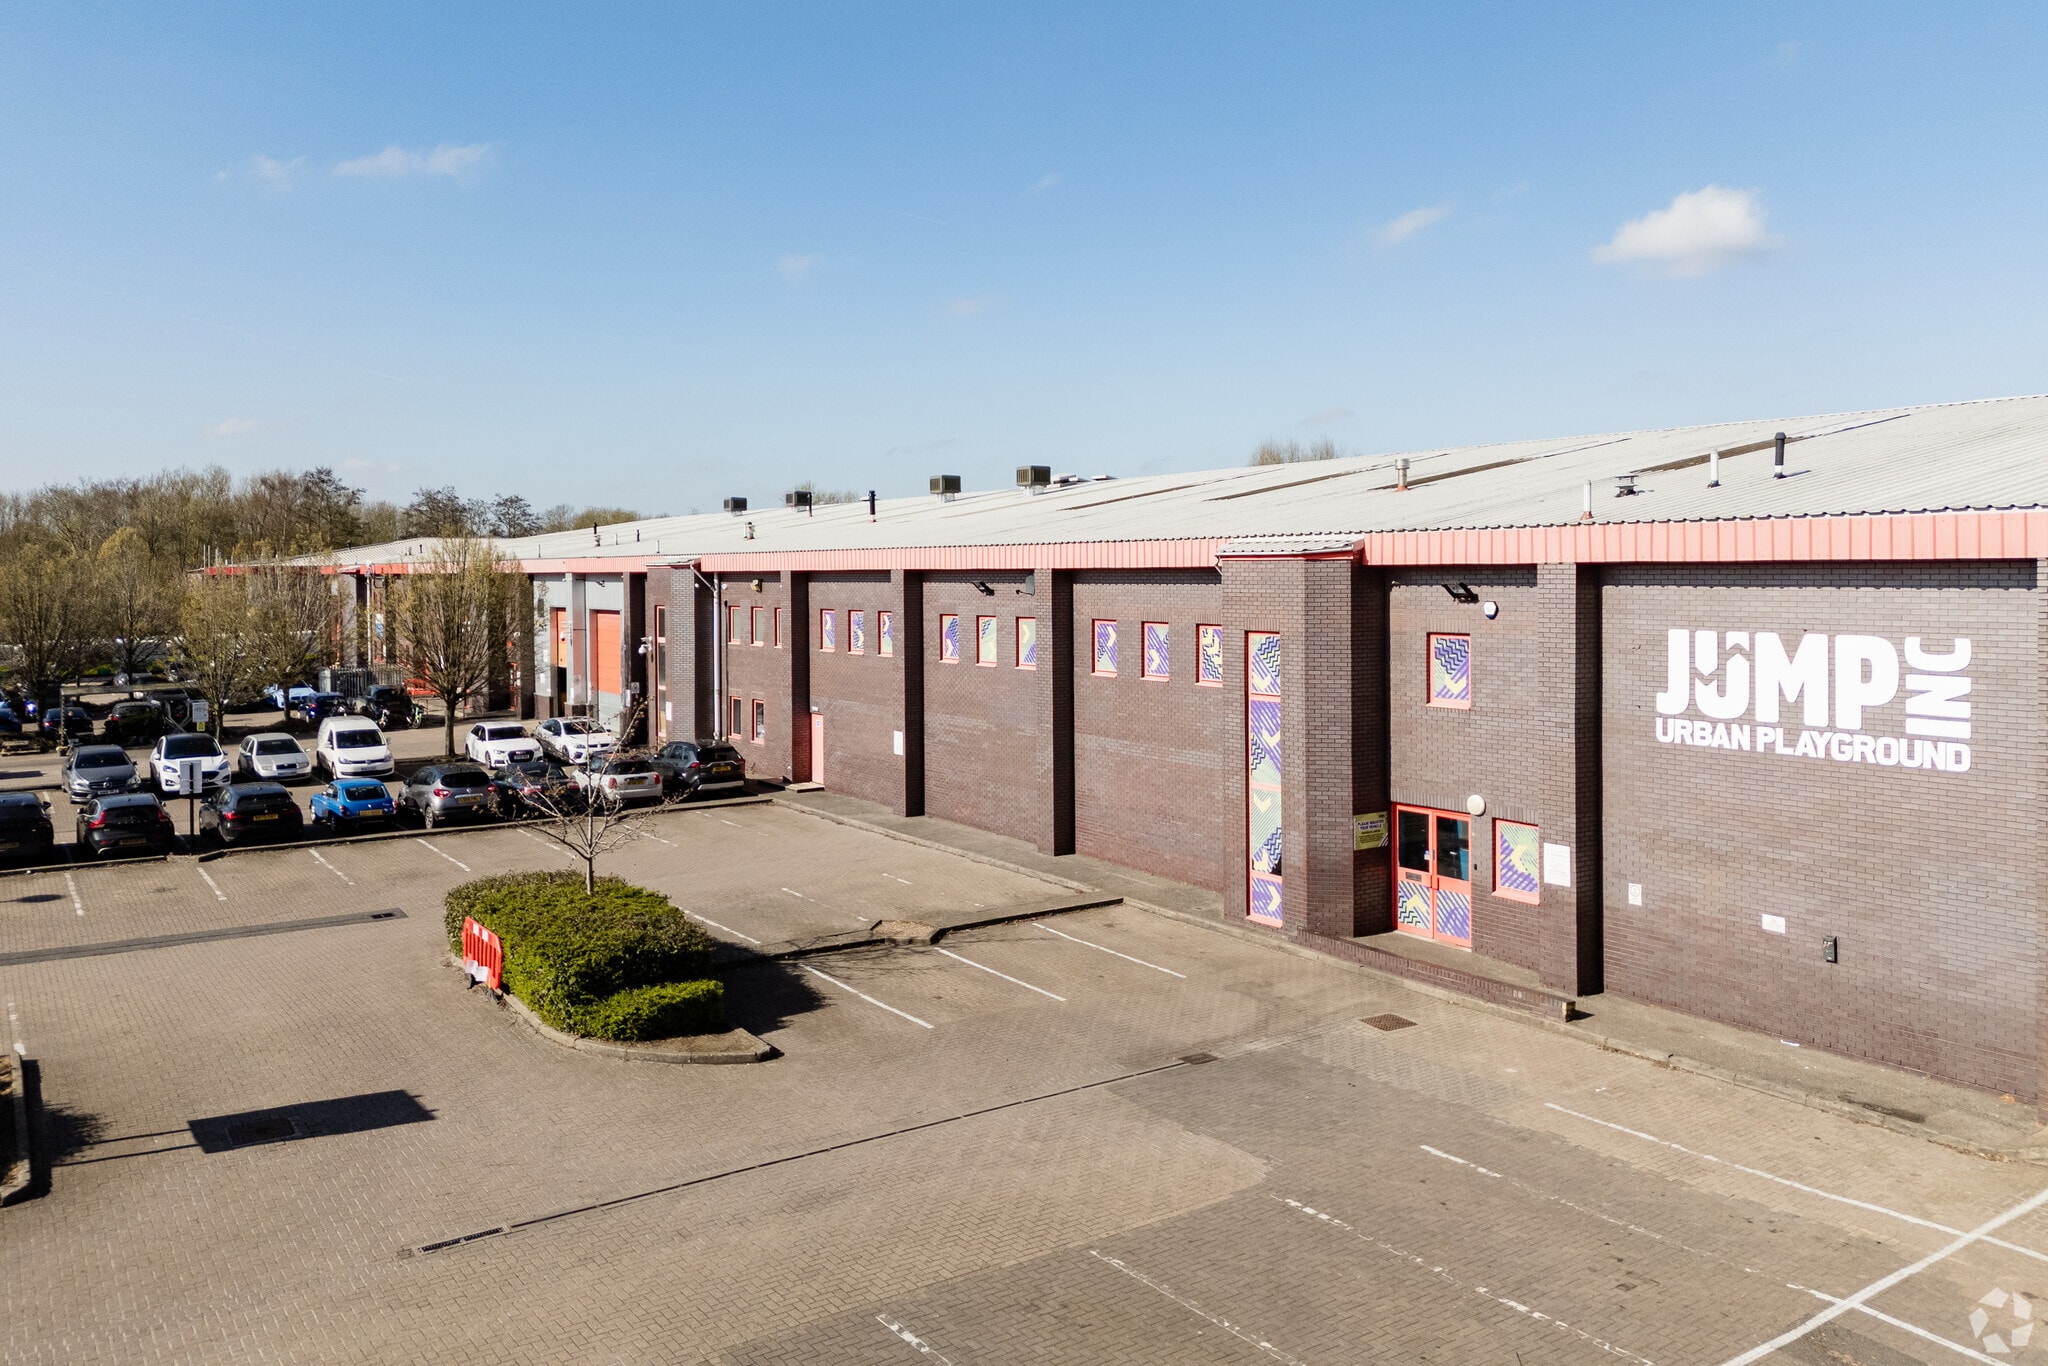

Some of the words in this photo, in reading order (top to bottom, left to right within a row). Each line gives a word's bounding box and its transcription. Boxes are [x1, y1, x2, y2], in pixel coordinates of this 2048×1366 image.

[1656, 629, 1899, 730] JUMP
[1904, 637, 1972, 739] INC
[1656, 716, 1750, 750] URBAN
[1756, 726, 1971, 772] PLAYGROUND
